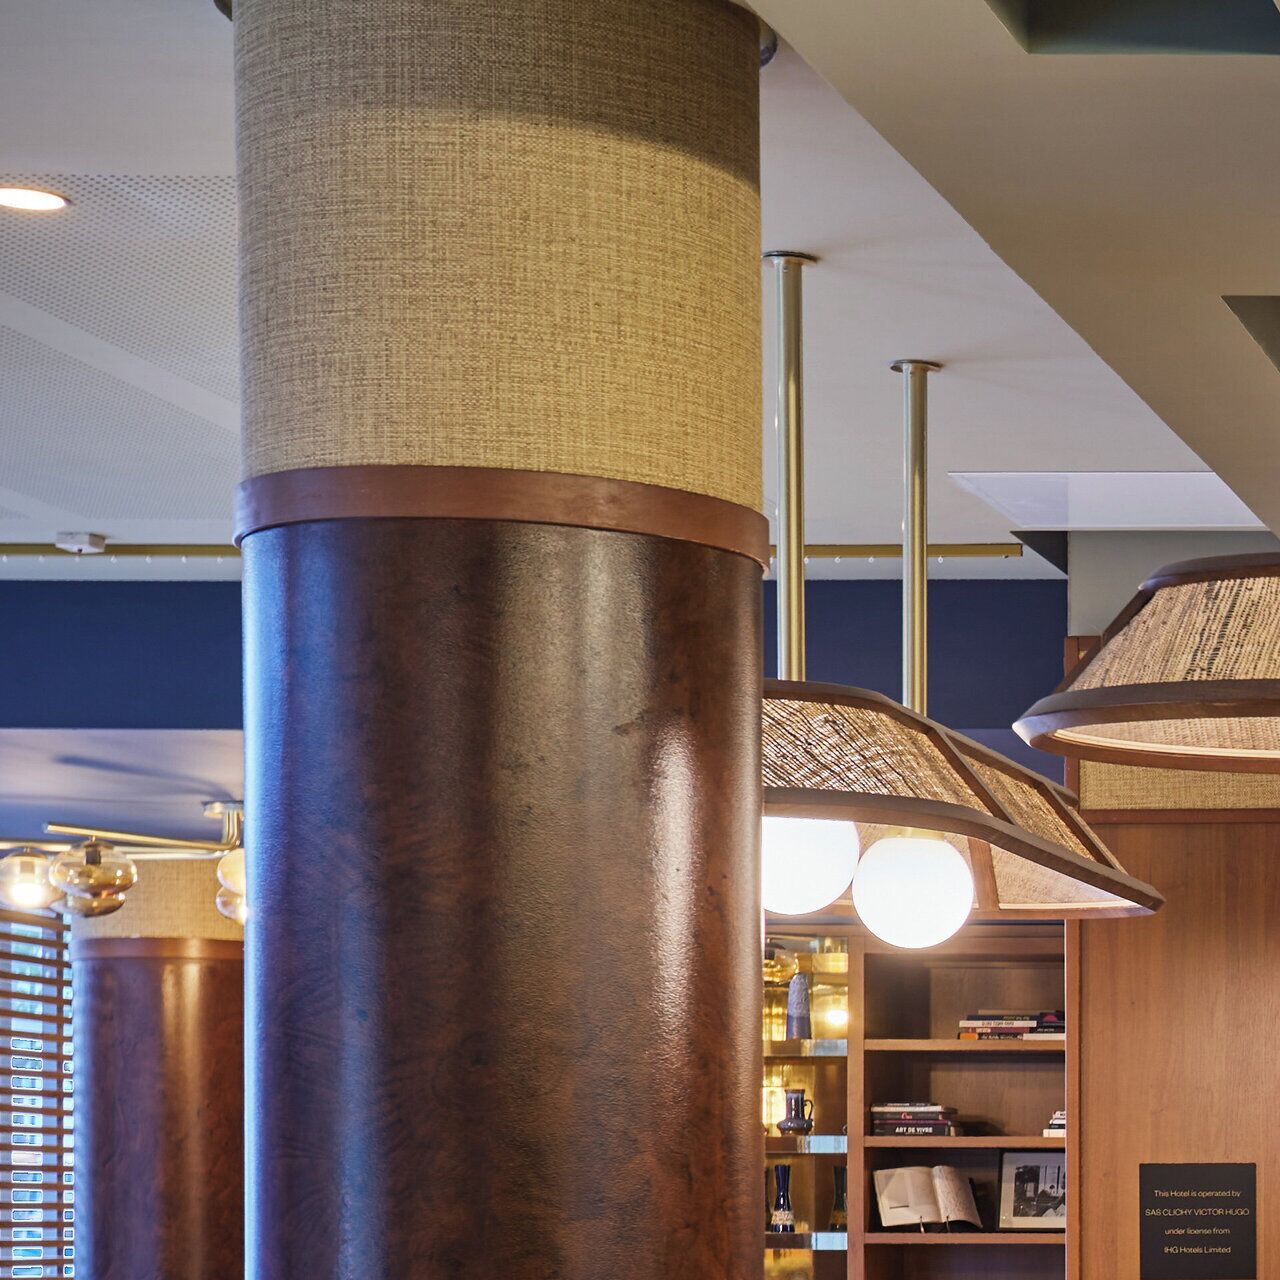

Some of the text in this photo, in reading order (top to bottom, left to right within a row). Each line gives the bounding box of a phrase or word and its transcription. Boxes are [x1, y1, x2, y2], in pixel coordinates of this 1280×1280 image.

[1154, 1190, 1241, 1199] This Hotel is operated by
[1145, 1208, 1250, 1216] SAS CLICHY VICTOR HUGO
[1164, 1227, 1185, 1235] under
[1212, 1227, 1231, 1235] from
[1164, 1246, 1232, 1254] IHG Hotels Limited
